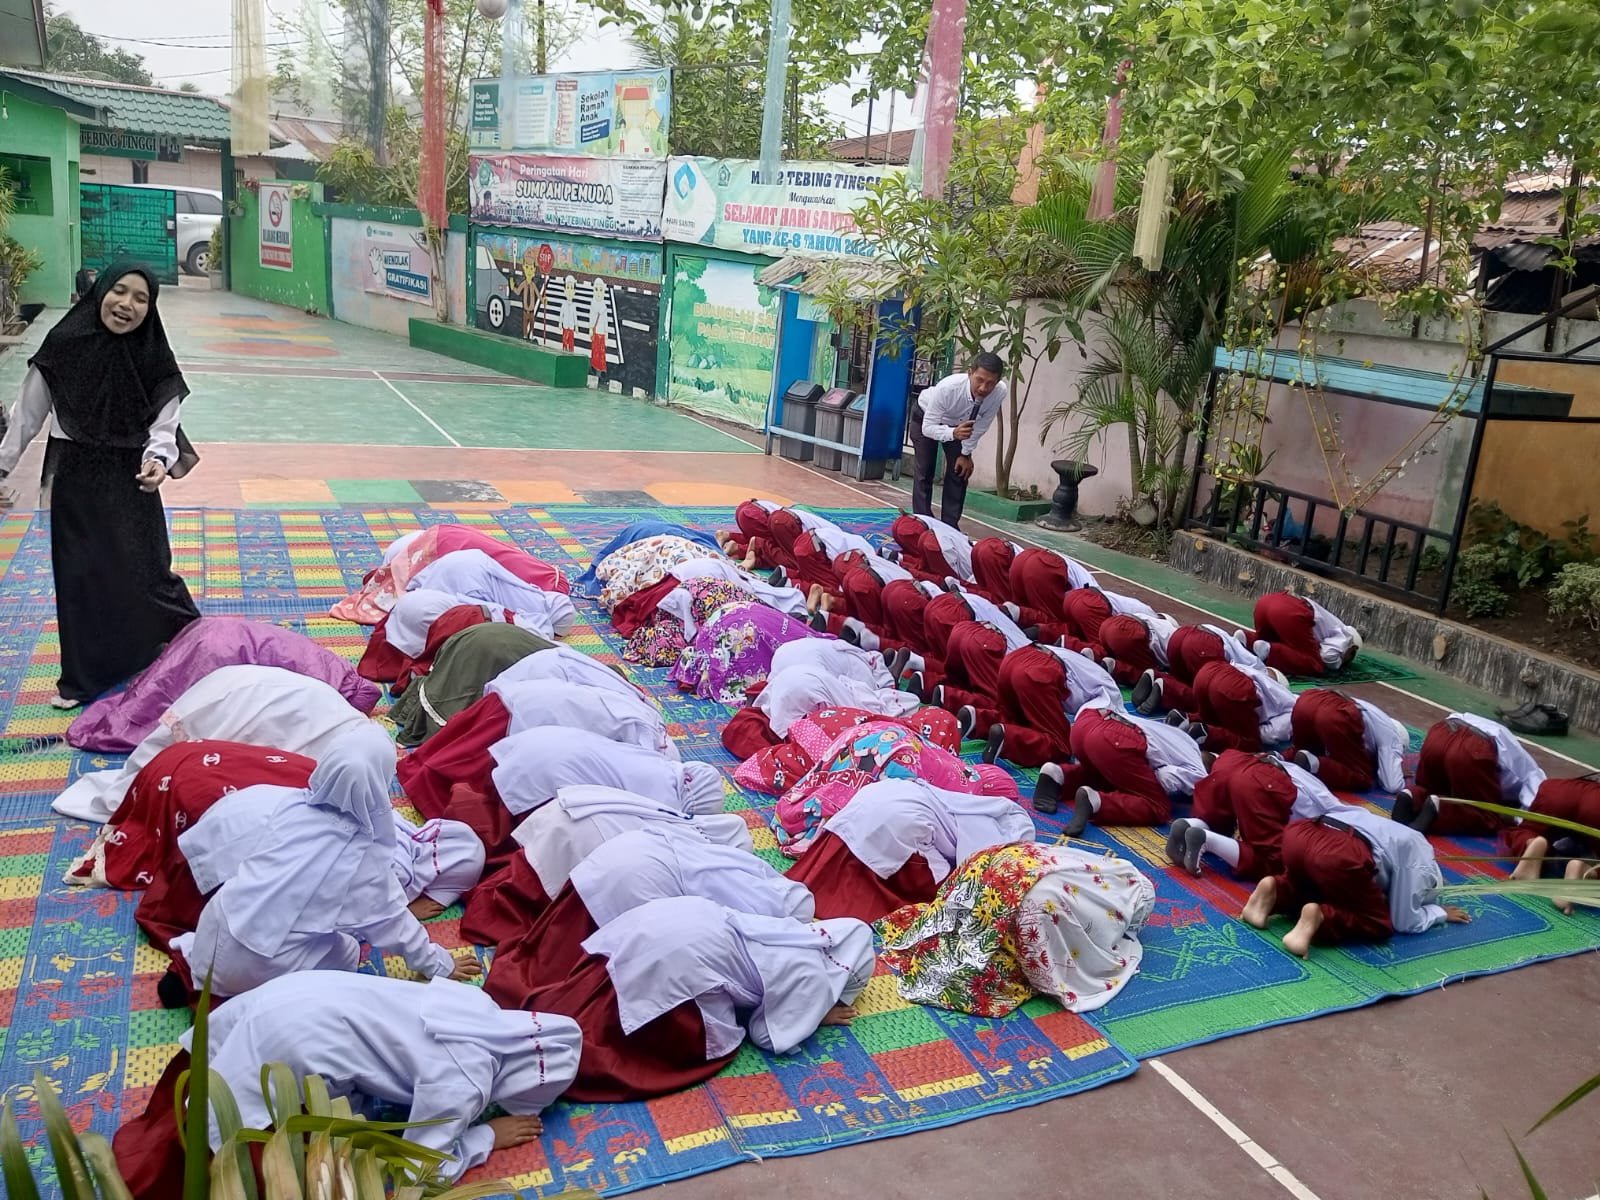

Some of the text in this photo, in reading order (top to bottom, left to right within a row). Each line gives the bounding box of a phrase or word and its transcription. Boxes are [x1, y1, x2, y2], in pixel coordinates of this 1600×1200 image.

[581, 89, 609, 104] Sekolah
[580, 101, 605, 114] Ramah
[580, 112, 599, 123] Anak
[81, 131, 156, 152] TEBING TINGGI
[520, 165, 589, 178] Peringatan Hari
[787, 171, 832, 188] TEBING
[515, 180, 563, 201] SUMPAH
[563, 182, 614, 205] PEMUDA
[567, 214, 591, 228] TEBING
[592, 218, 617, 230] TINGGI
[724, 203, 778, 226] SELAMAT
[780, 207, 811, 228] HARI
[742, 228, 772, 245] YANG
[772, 230, 802, 249] KE-8
[803, 233, 842, 254] TAHUN
[384, 254, 409, 267] MENOLAK
[387, 272, 427, 291] GRATIFIKASI
[975, 1069, 1051, 1101] LAUT
